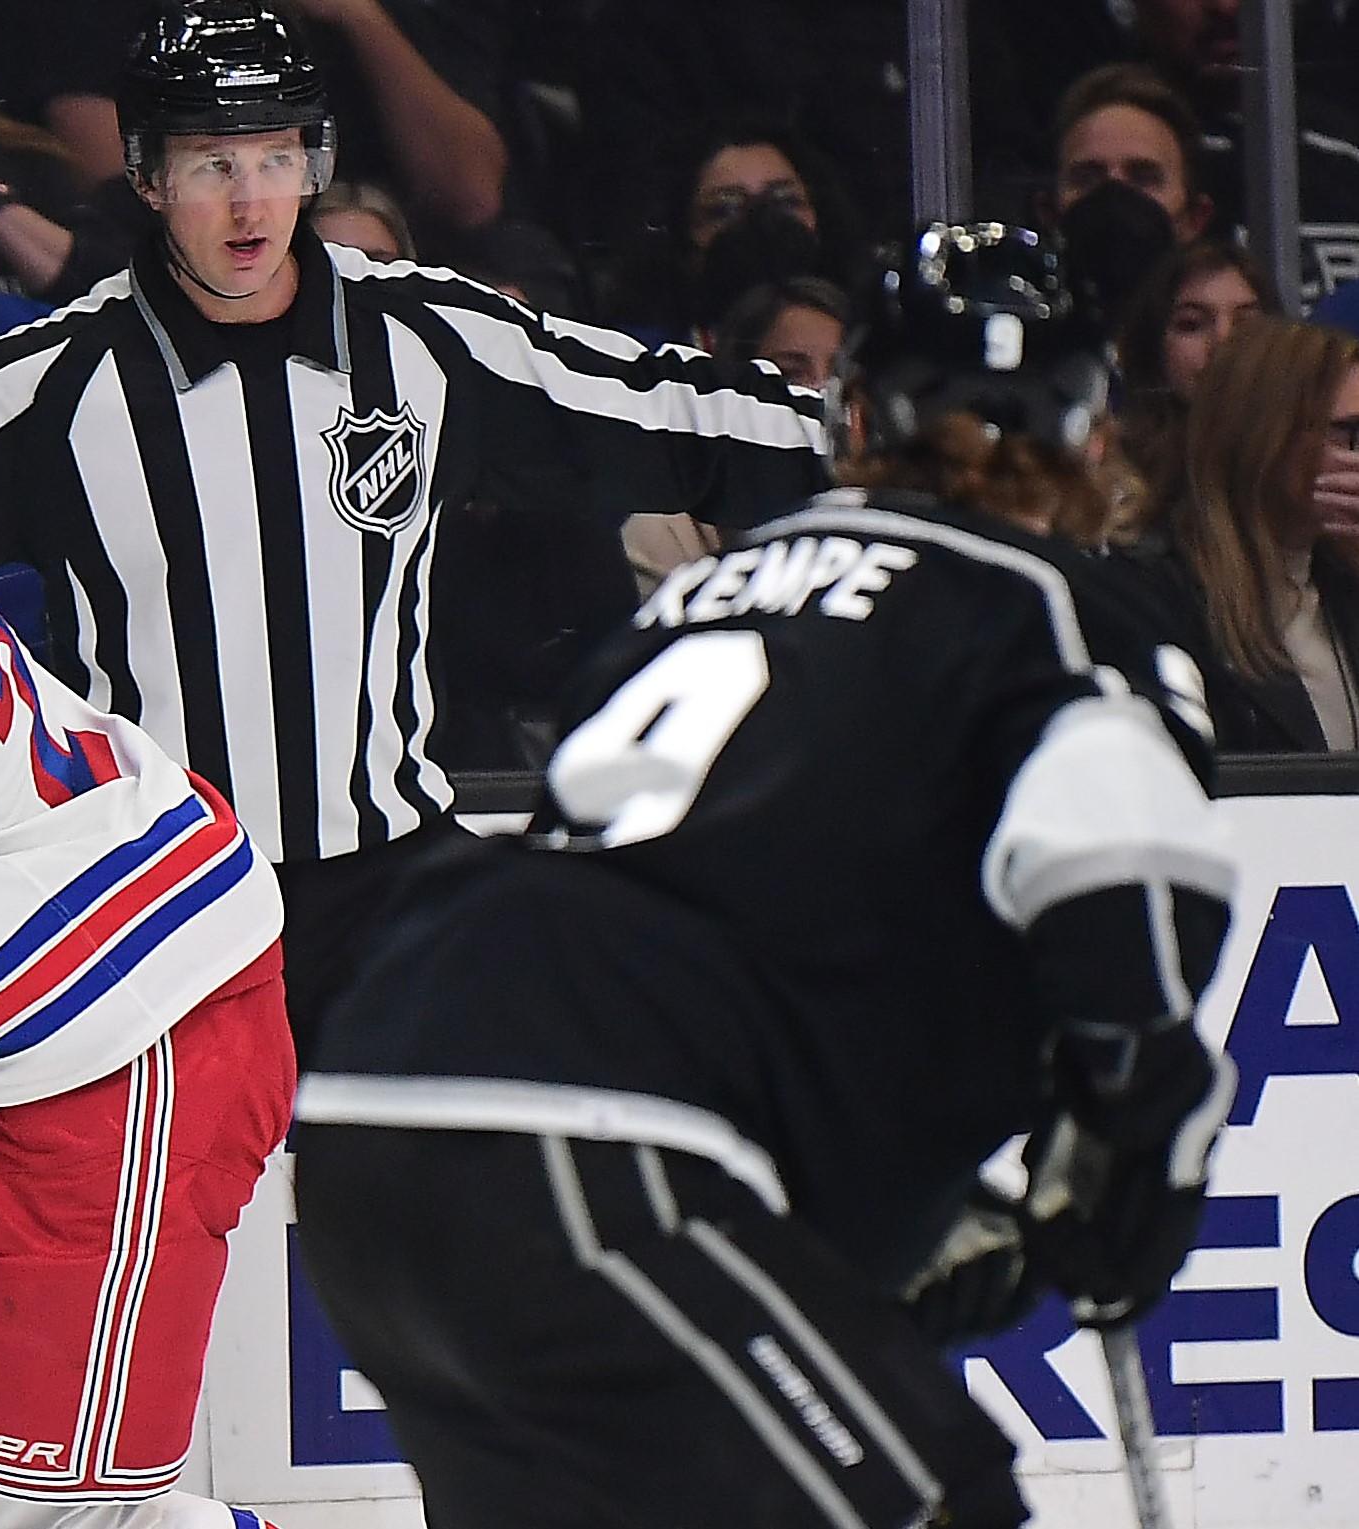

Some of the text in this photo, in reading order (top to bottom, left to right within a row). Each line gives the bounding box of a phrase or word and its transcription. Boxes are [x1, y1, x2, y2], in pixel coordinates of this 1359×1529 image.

[356, 440, 412, 510] NHL
[632, 535, 921, 631] KEMPE
[545, 628, 773, 851] 9
